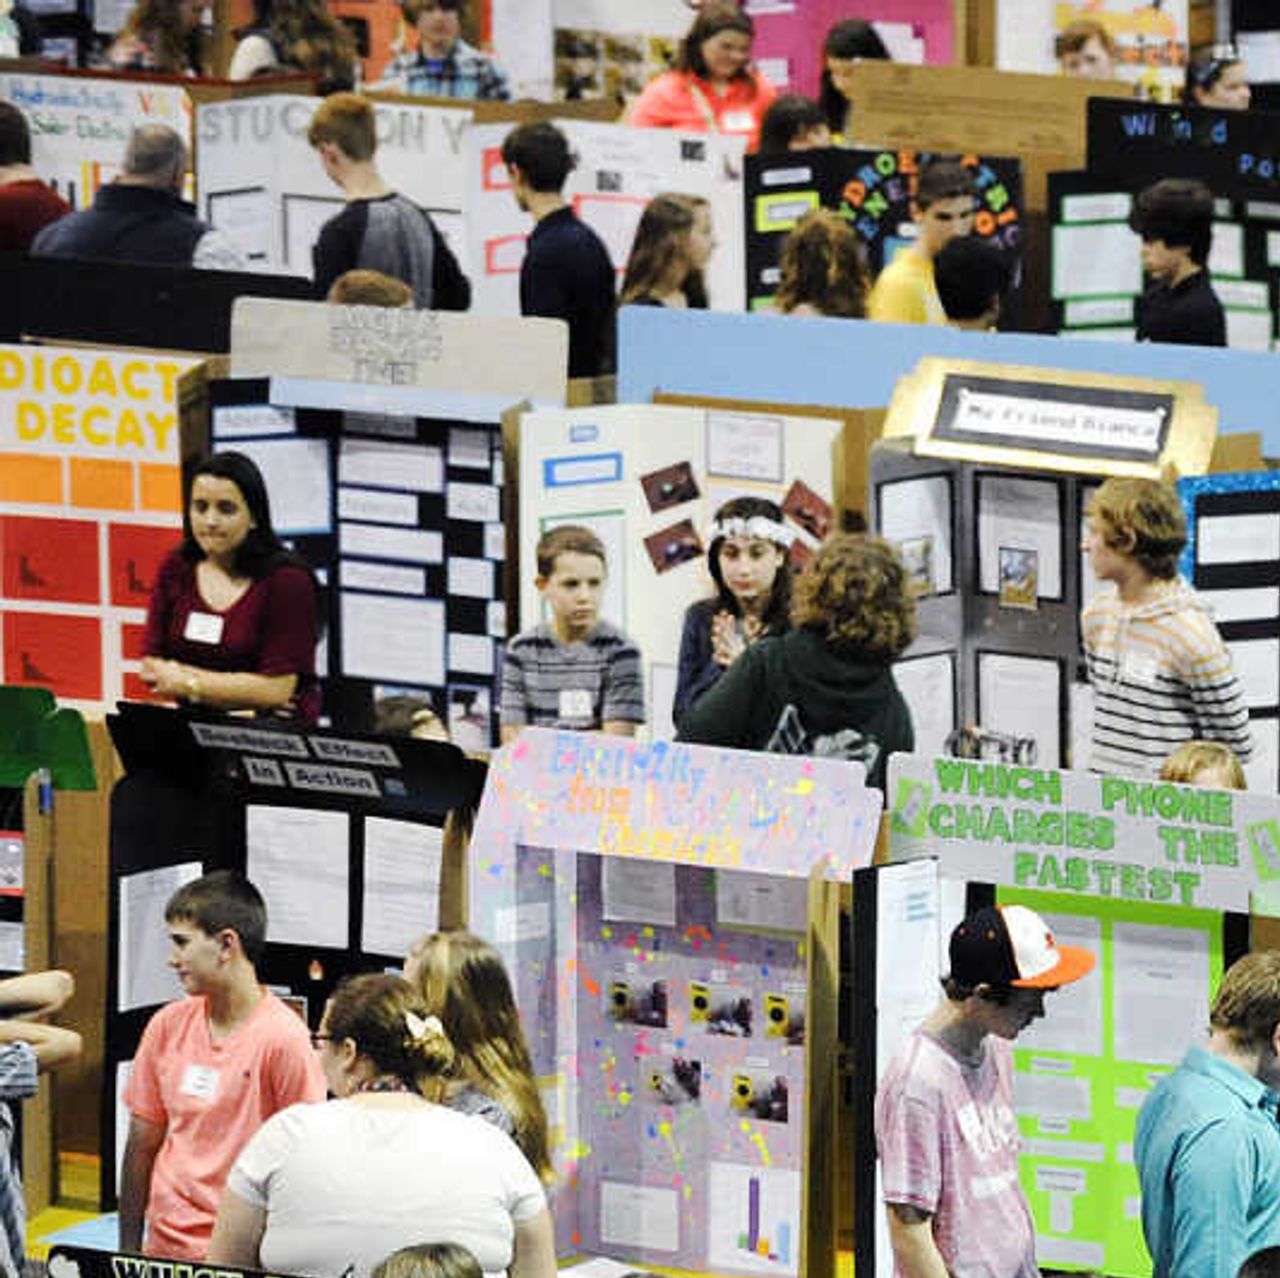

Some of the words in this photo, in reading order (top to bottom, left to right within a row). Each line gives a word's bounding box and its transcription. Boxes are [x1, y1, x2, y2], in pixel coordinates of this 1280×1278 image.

[201, 105, 309, 142] STUC
[17, 399, 174, 450] DECAY
[934, 759, 1061, 803] WHICH
[1101, 775, 1234, 828] PHONE
[928, 803, 1114, 850] CHARGES
[1159, 825, 1238, 868] THE
[1016, 851, 1200, 905] FASTEST
